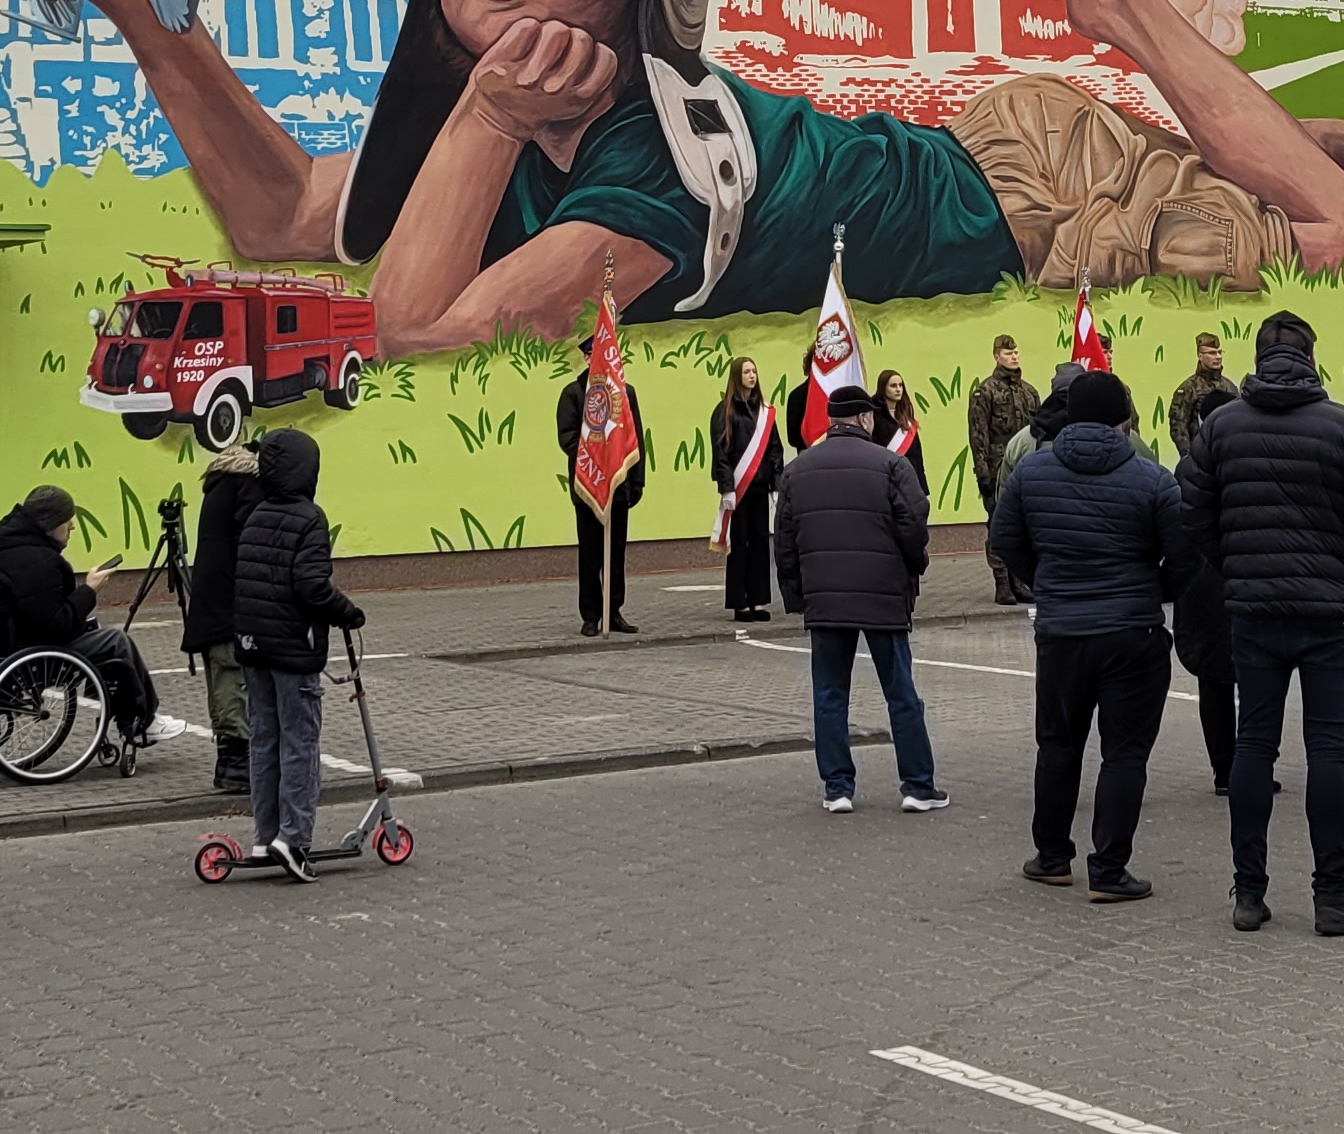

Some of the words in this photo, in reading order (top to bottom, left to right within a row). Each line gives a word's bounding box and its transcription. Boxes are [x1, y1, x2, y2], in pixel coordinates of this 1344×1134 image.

[194, 341, 224, 355] OSP
[173, 355, 224, 368] Krzesiny
[176, 370, 205, 383] 1920
